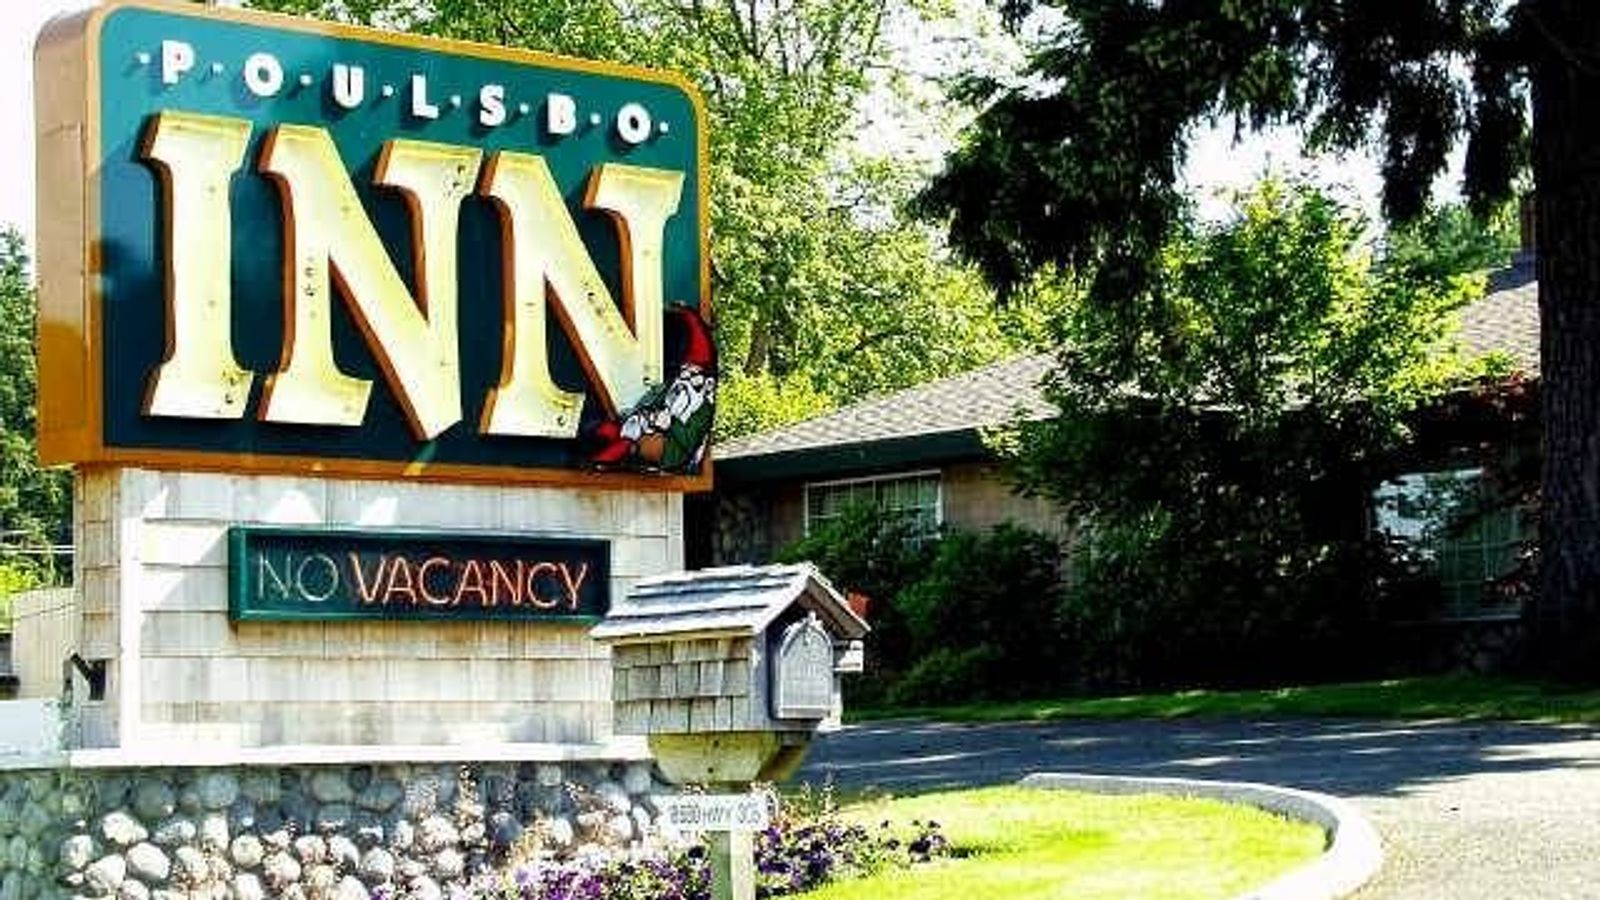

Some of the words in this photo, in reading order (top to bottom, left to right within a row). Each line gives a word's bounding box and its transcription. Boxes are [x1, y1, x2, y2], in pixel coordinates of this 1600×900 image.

[141, 110, 684, 442] INN
[257, 552, 340, 602] NO
[346, 550, 588, 610] VACANCY
